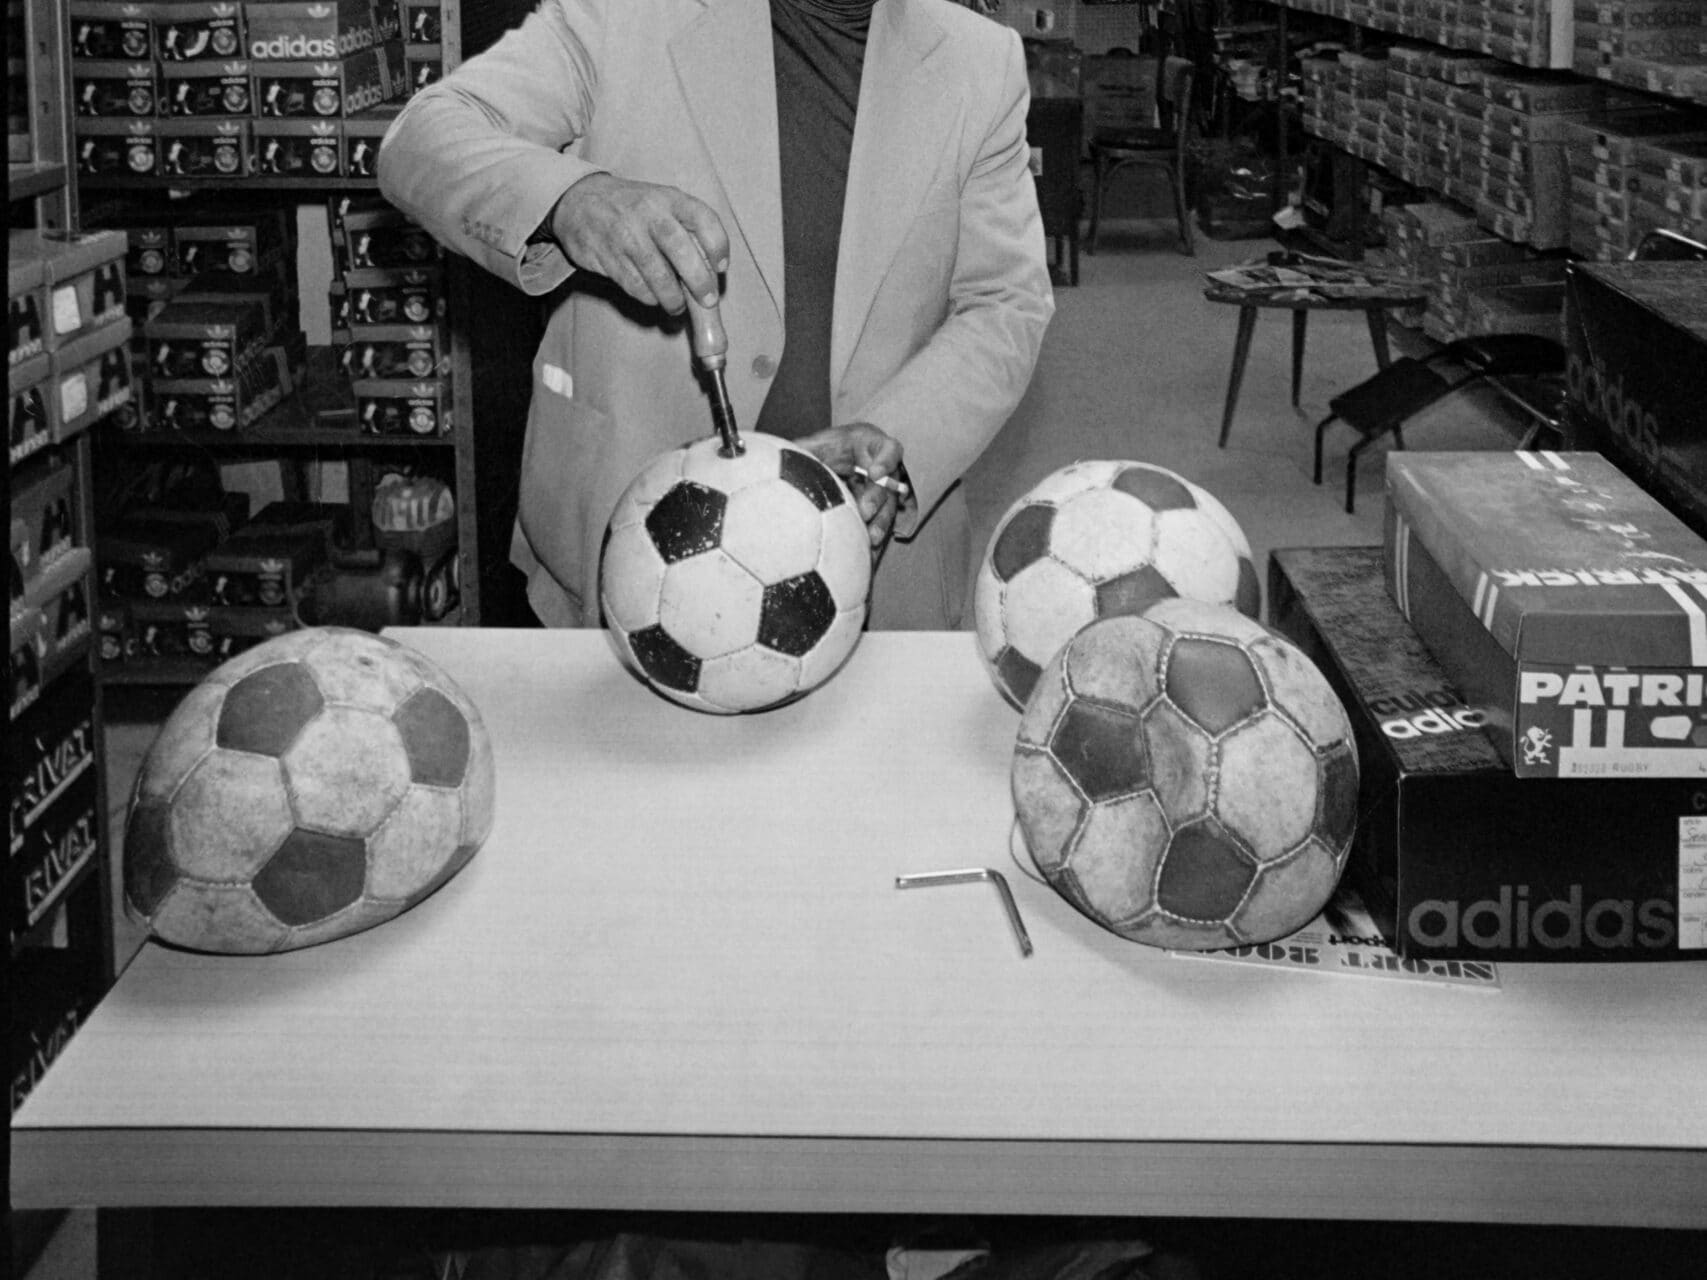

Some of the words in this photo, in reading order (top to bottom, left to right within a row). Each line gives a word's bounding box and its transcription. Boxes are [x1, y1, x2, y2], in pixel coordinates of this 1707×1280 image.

[251, 33, 336, 59] adidas
[1567, 353, 1660, 467] adidas
[1491, 568, 1707, 587] ATRICK
[1407, 883, 1676, 950] adidas
